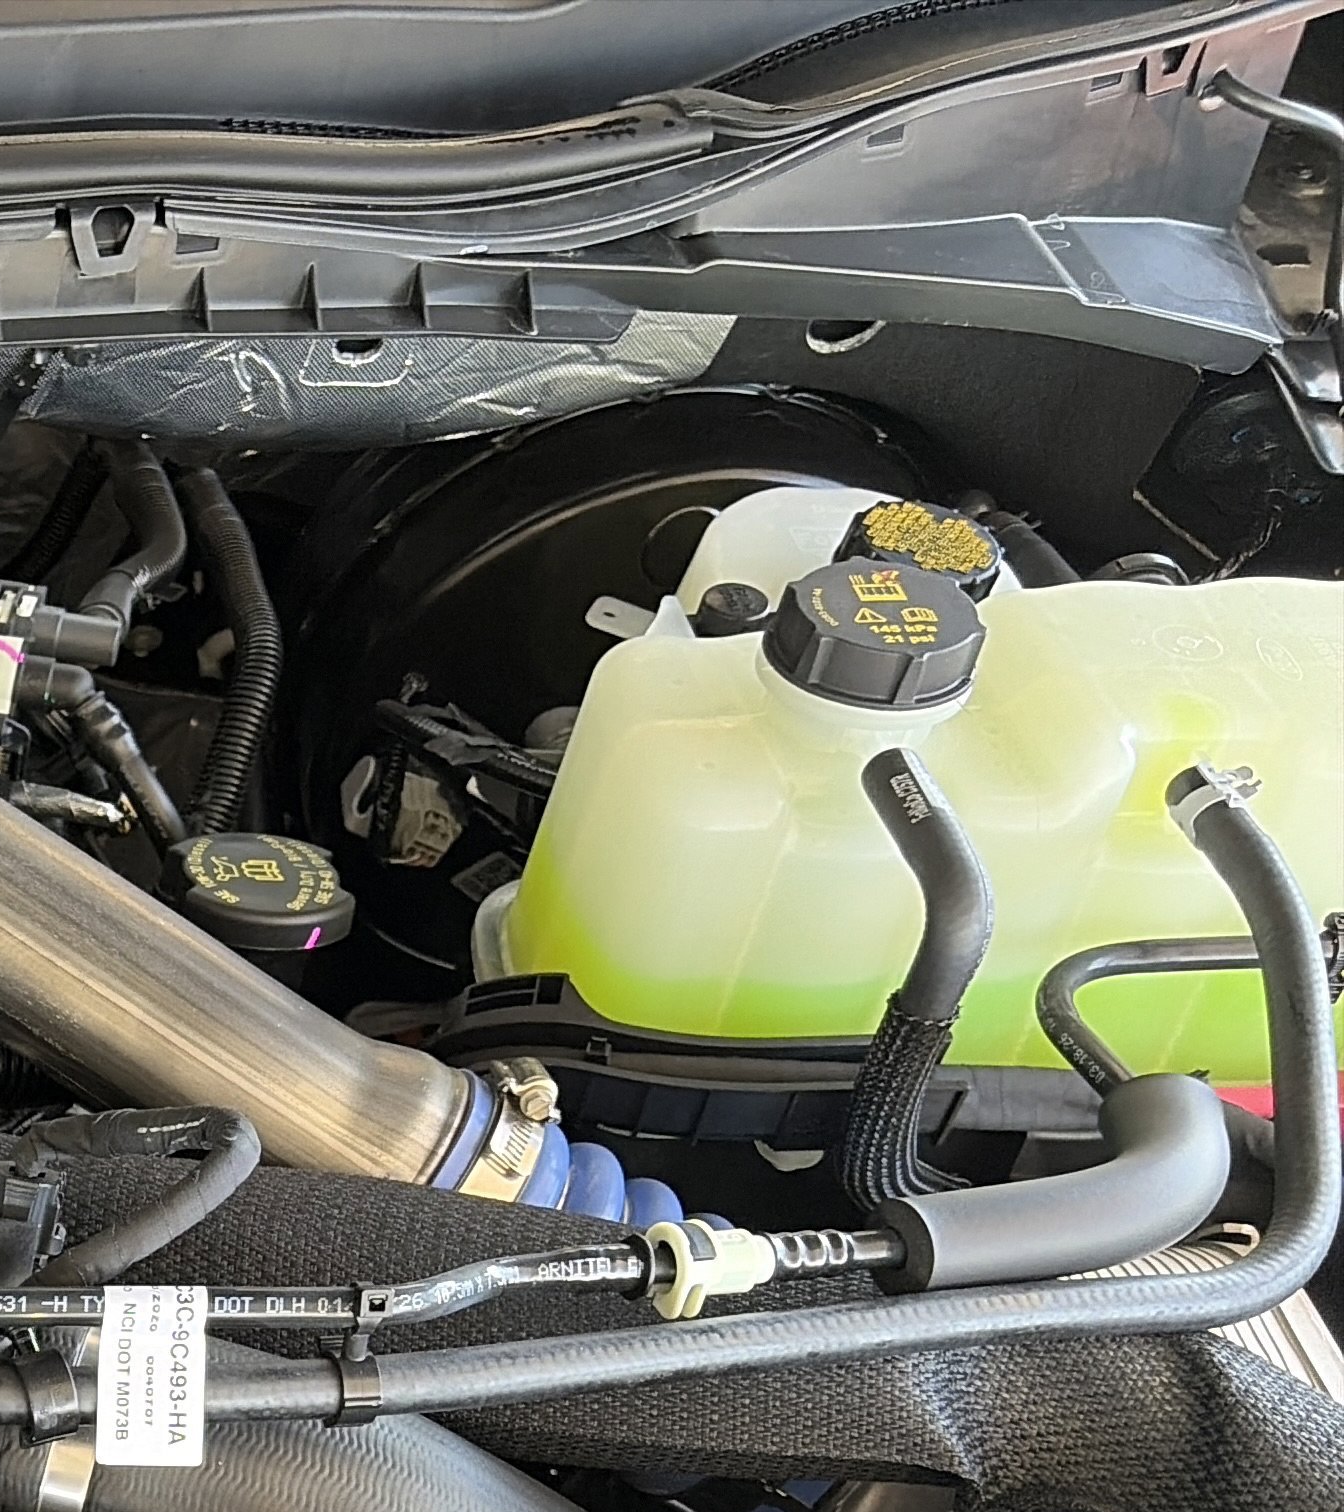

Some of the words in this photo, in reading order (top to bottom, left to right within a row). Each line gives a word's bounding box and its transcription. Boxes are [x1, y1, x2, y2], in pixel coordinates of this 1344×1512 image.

[80, 1295, 106, 1313] TY
[214, 1296, 254, 1315] DOT
[265, 1296, 306, 1314] DLH
[537, 1256, 612, 1279] ARNITEL
[117, 1338, 132, 1376] DOT
[115, 1381, 131, 1441] M073B
